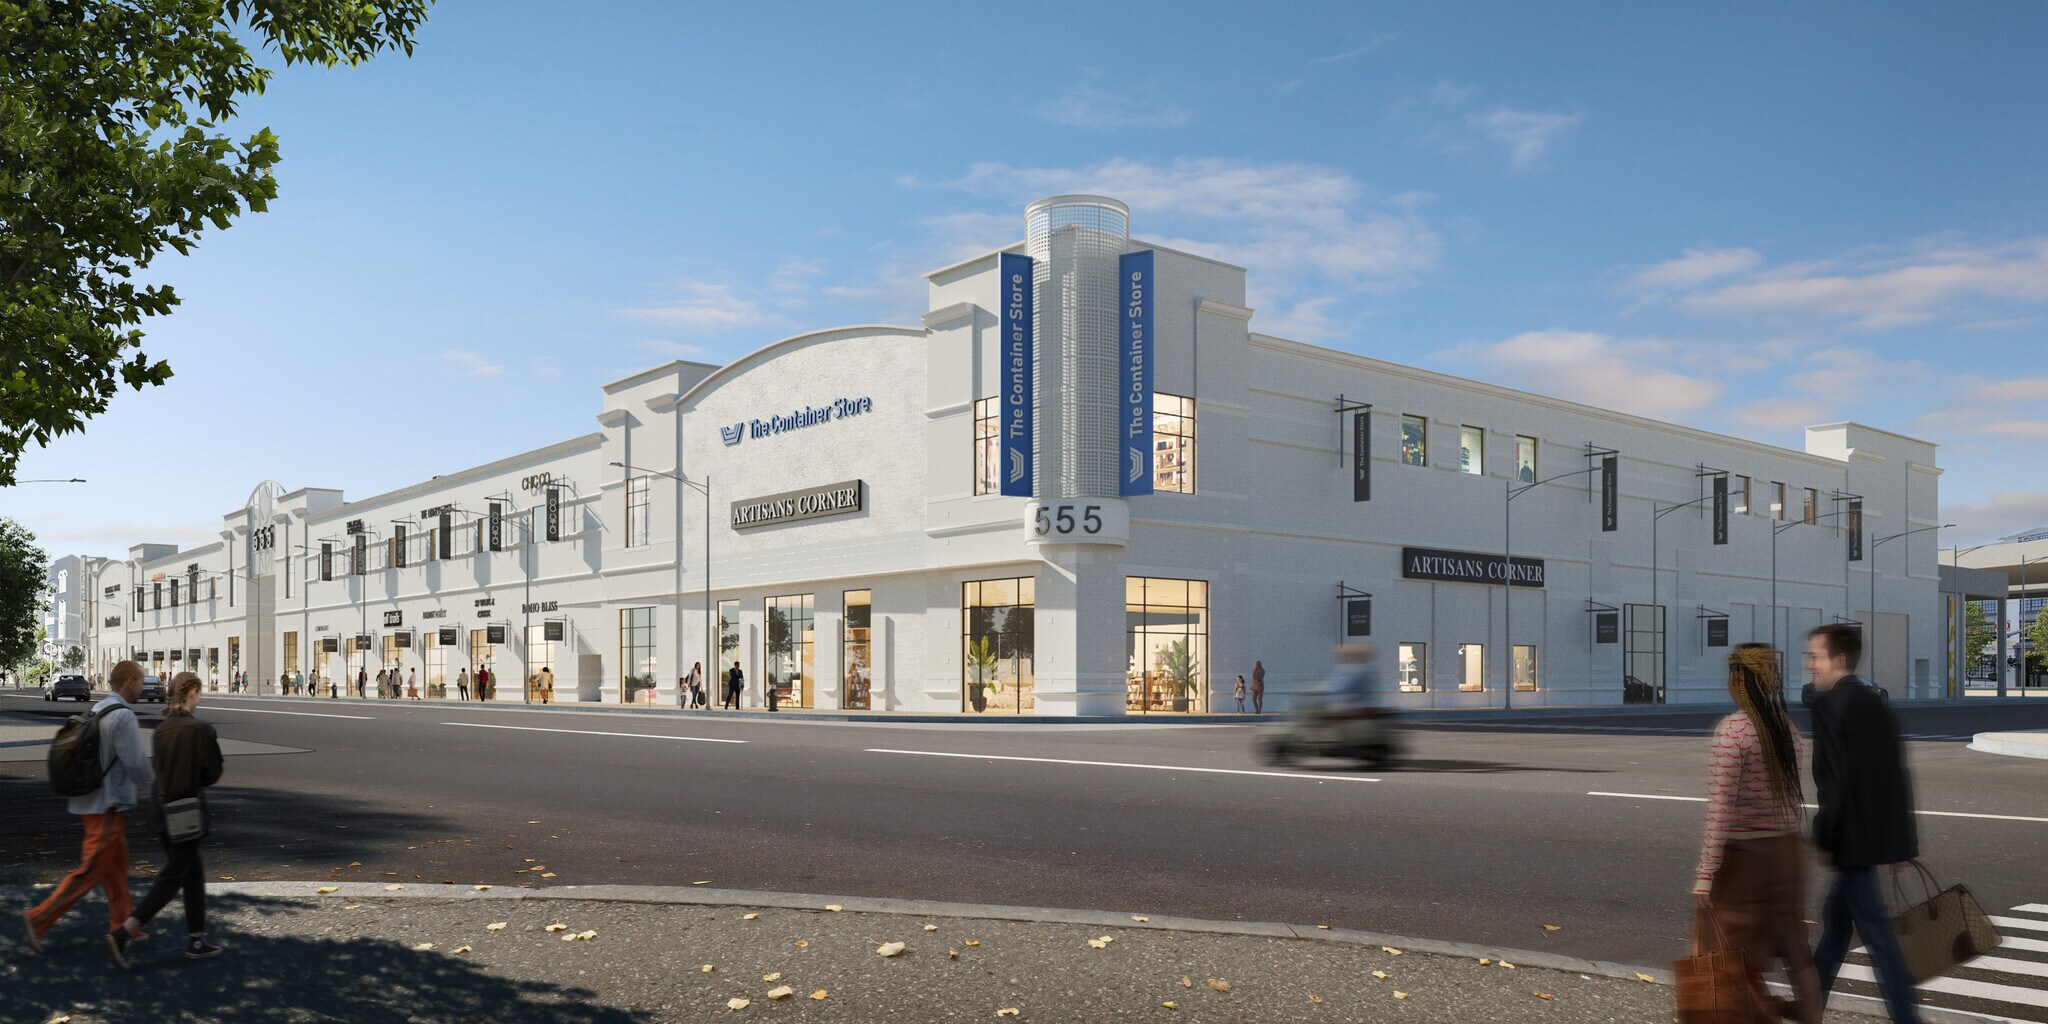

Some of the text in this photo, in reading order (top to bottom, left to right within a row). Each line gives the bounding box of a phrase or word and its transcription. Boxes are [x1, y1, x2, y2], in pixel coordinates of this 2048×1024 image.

[1009, 274, 1024, 439] The Container Store
[1128, 271, 1143, 437] The Container Store
[748, 396, 872, 439] The Container Store
[522, 474, 539, 491] CHIC
[732, 487, 858, 525] ARTISANS CORNER
[1034, 505, 1103, 536] 555
[253, 525, 275, 551] 555
[491, 525, 499, 545] CHIC
[549, 513, 557, 534] CHIC
[1411, 555, 1543, 582] ARTISANS CORNER
